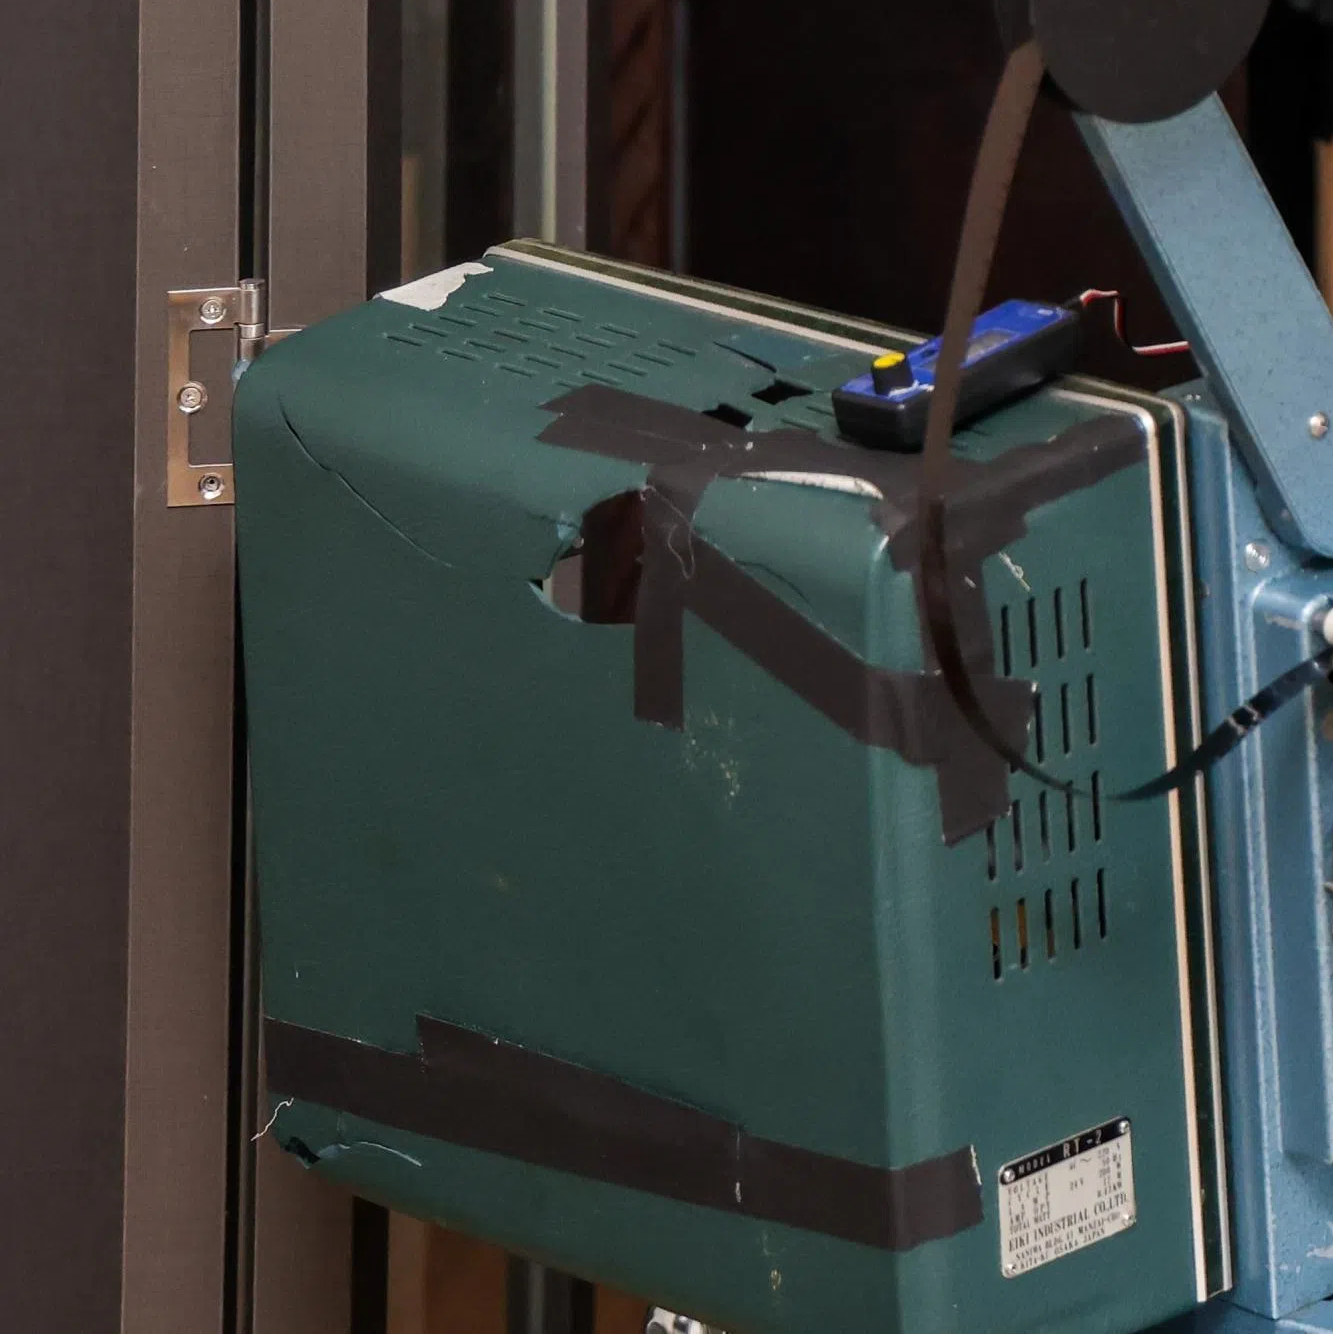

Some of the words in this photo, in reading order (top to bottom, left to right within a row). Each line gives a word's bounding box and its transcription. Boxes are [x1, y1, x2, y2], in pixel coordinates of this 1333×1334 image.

[1062, 1128, 1102, 1159] RT-2
[1008, 1231, 1029, 1253] EIKI
[1033, 1206, 1088, 1242] INDUSTRIAL
[1083, 1226, 1105, 1243] JAPAN
